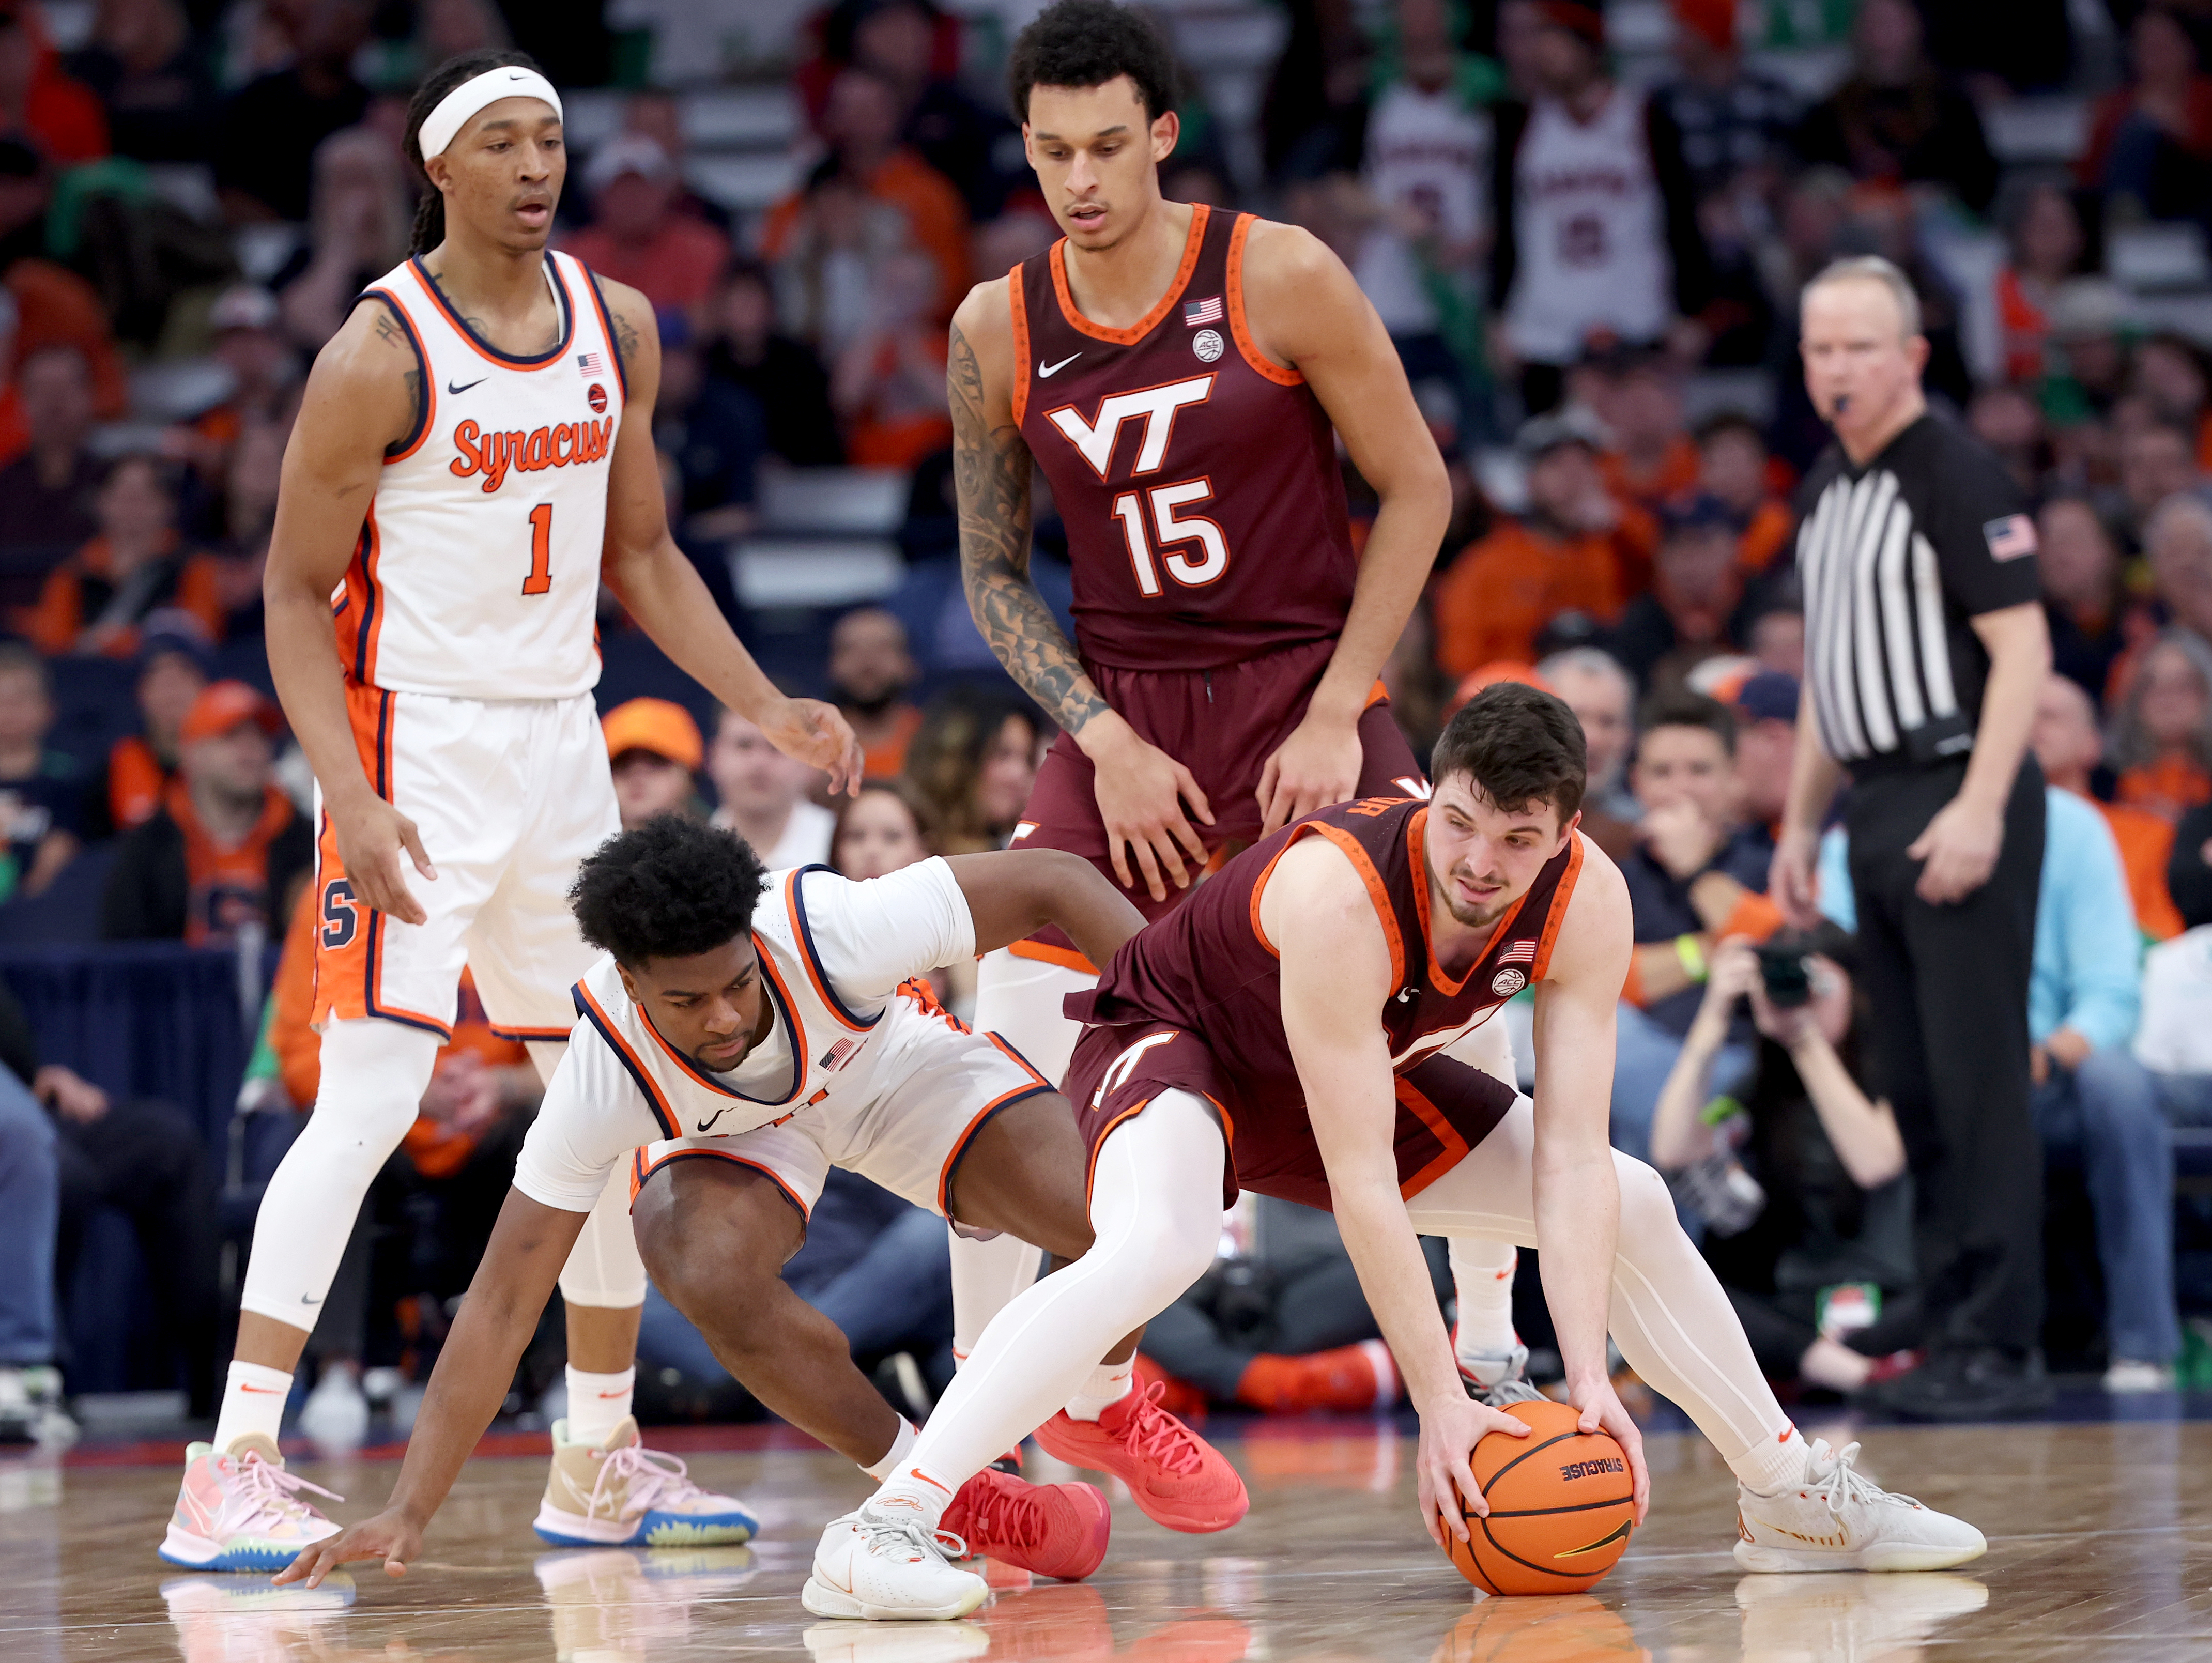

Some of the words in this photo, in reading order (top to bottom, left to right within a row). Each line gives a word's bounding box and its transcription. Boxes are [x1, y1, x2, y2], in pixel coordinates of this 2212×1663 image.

[1042, 371, 1219, 483] VT
[521, 502, 552, 595] 1
[1111, 475, 1231, 597] 15
[321, 877, 358, 951] S
[1559, 1458, 1624, 1482] SYRACUSE
